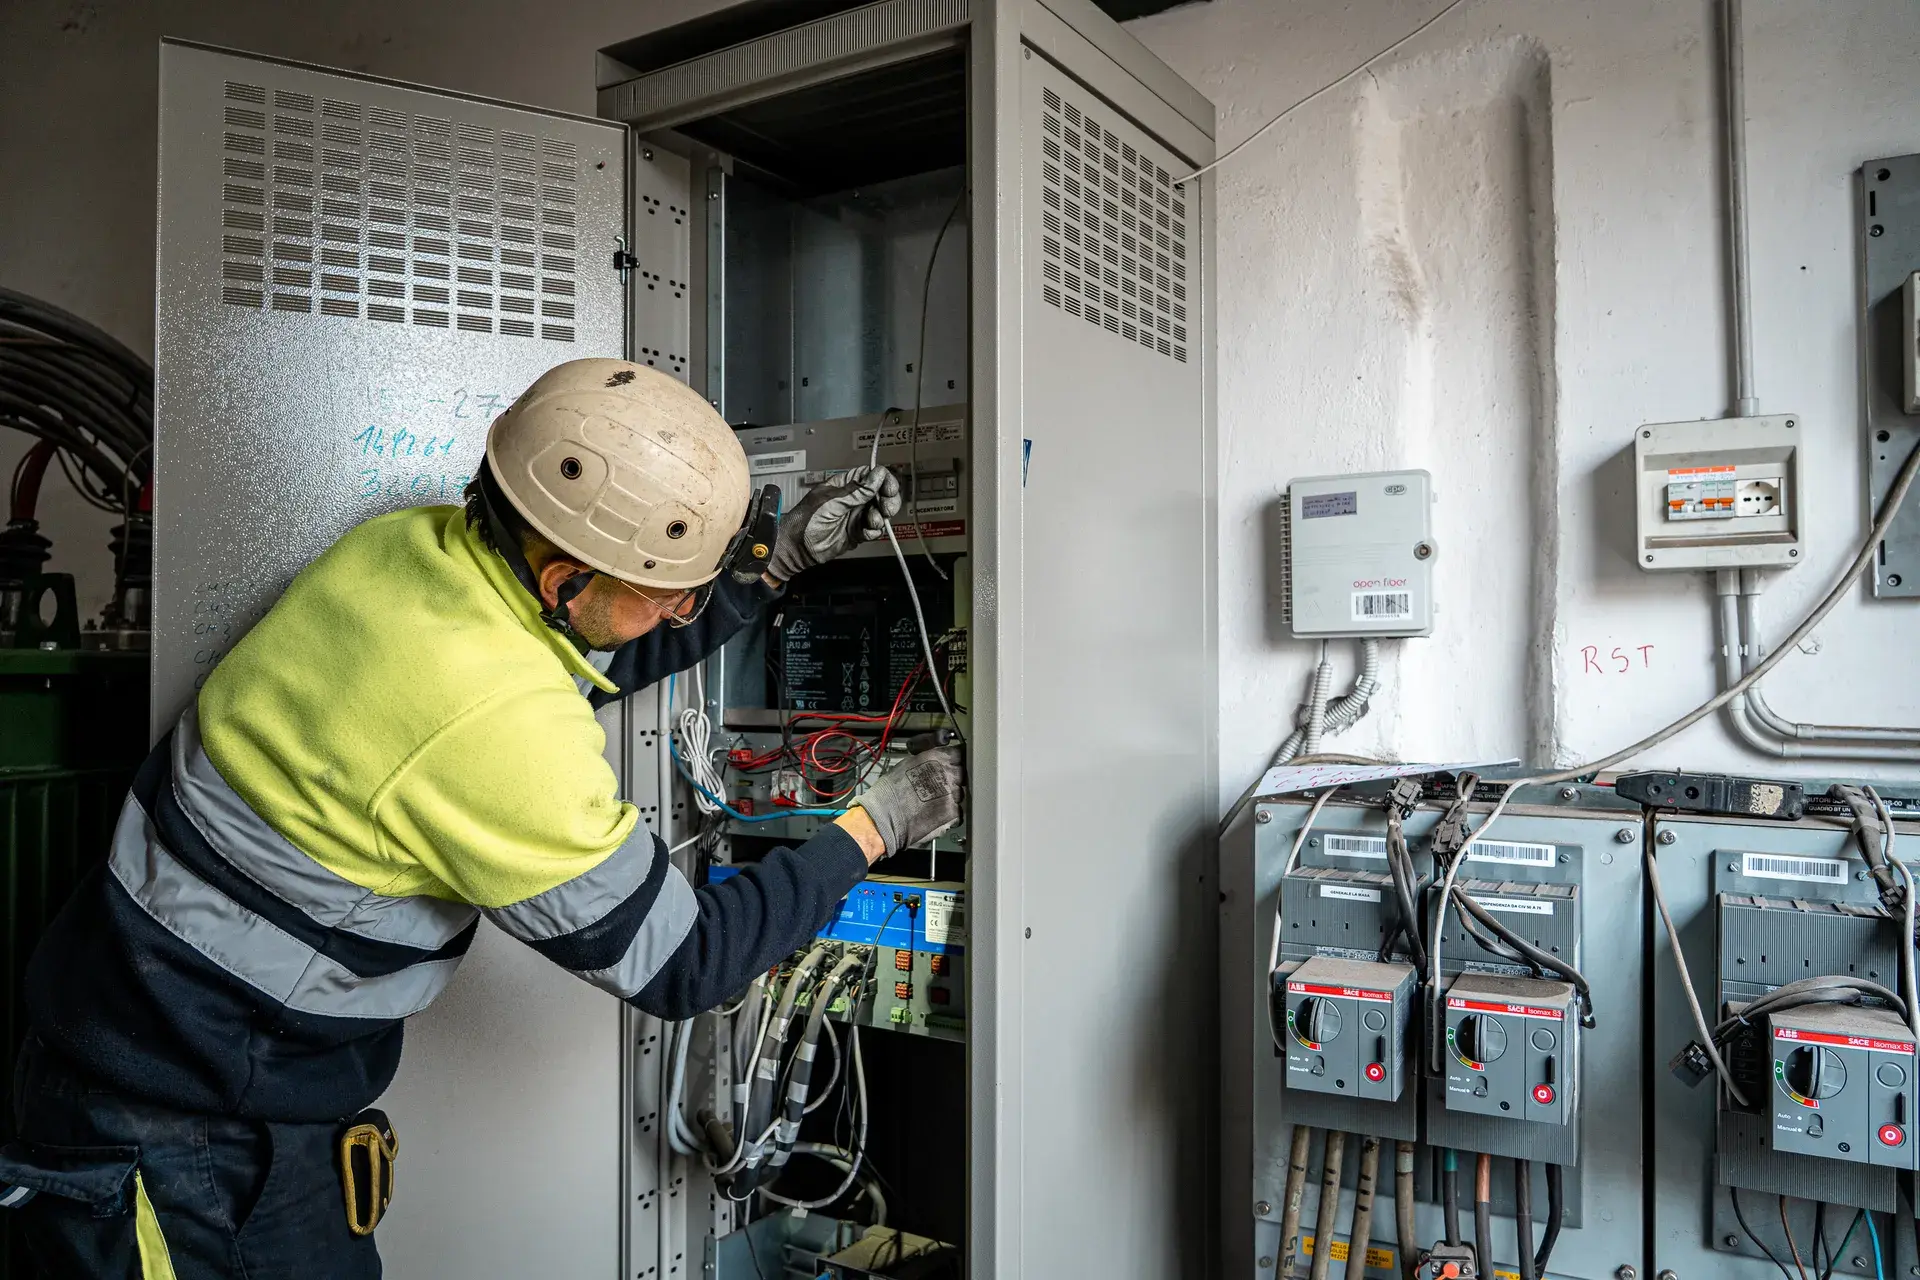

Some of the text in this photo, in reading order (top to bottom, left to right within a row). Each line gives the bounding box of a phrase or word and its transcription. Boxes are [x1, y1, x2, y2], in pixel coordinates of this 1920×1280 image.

[909, 505, 954, 515] CNCENTRATORE
[1353, 577, 1407, 589] open fiber
[1290, 983, 1306, 991] ABB
[1342, 989, 1360, 997] SACE
[1361, 990, 1383, 999] Isomax
[1449, 998, 1466, 1007] ABB
[1507, 1004, 1525, 1013] SACE
[1527, 1007, 1551, 1017] Isomax
[1777, 1029, 1798, 1038] ABB
[1848, 1037, 1870, 1046] SACE
[1873, 1041, 1902, 1050] Isomax
[1449, 1085, 1467, 1093] Manual
[1777, 1112, 1791, 1120] Auto
[1776, 1124, 1798, 1133] Manual
